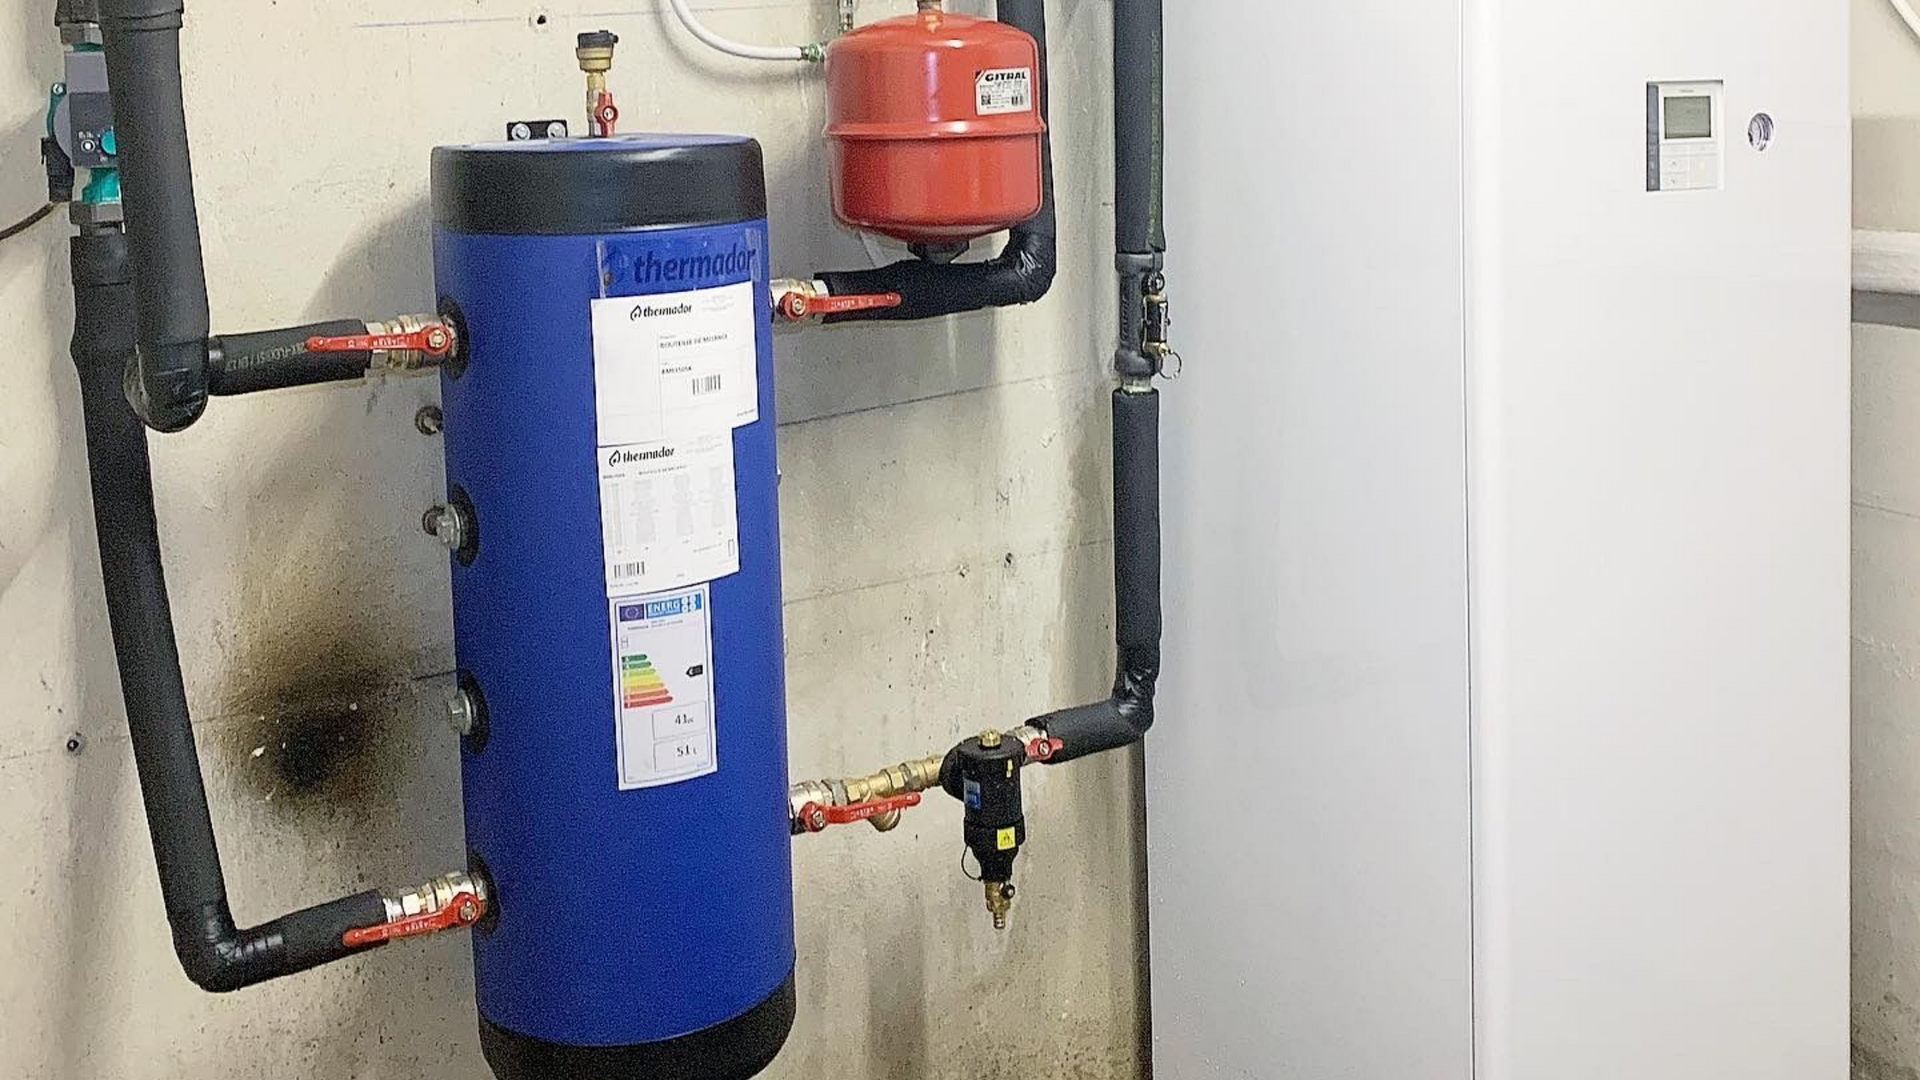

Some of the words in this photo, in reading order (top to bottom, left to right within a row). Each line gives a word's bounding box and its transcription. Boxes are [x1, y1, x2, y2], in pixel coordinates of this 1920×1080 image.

[633, 243, 757, 284] thermador
[643, 303, 693, 318] thermador
[622, 446, 675, 464] thermador
